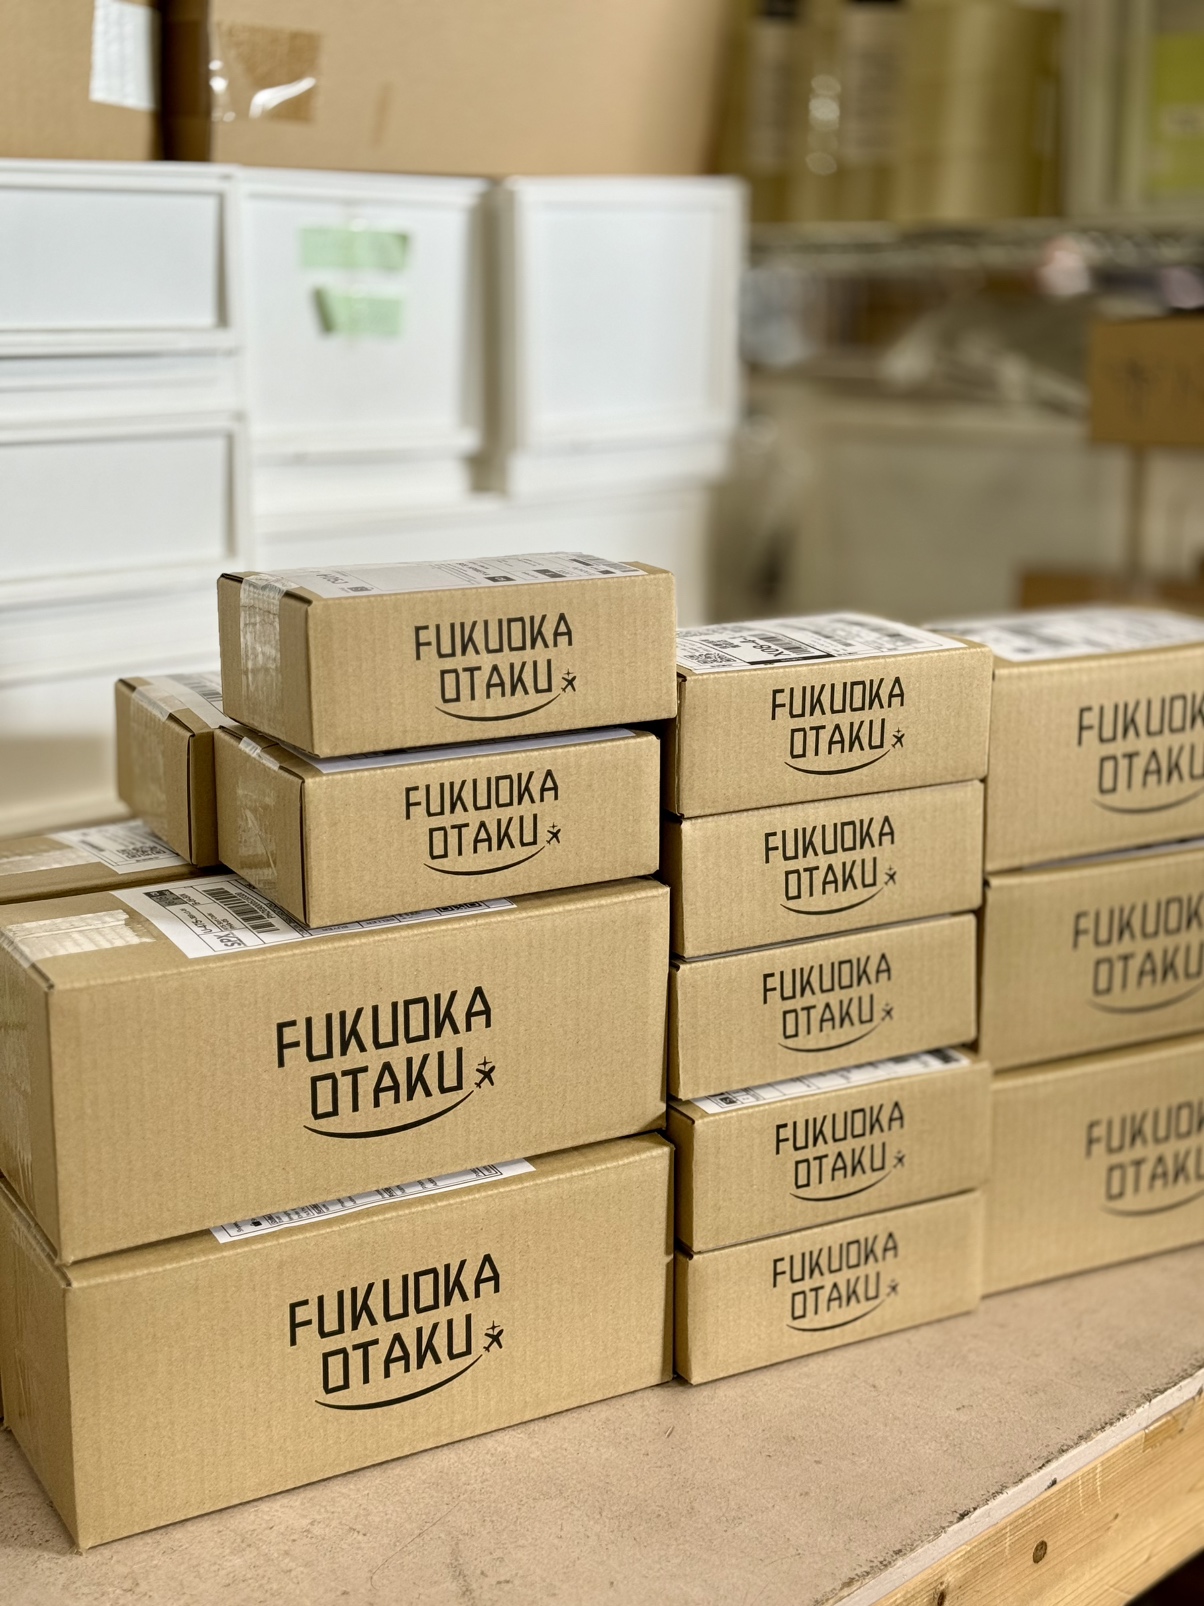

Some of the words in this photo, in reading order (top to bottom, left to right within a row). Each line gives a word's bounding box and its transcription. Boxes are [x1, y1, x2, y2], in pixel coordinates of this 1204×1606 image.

[414, 612, 573, 661] FUKUOKA
[439, 658, 553, 704] OTAKU
[771, 676, 905, 721] FUKUOKA
[789, 717, 886, 760] OTAKU
[404, 768, 559, 821] FUKUOKA
[1098, 743, 1204, 795] OTAKU
[428, 813, 538, 861] OTAKU
[764, 815, 895, 865] FUKUOKA
[784, 856, 877, 902] OTAKU
[762, 952, 891, 1005] FUKUOKA
[1093, 941, 1204, 996] OTAKU
[276, 985, 492, 1069] FUKUOKA
[782, 993, 874, 1040] OTAKU
[310, 1046, 464, 1121] OTAKU
[775, 1100, 904, 1156] FUKUOKA
[794, 1141, 886, 1190] OTAKU
[772, 1231, 898, 1289] FUKUOKA
[288, 1253, 500, 1347] FUKUOKA
[791, 1271, 880, 1321] OTAKU
[321, 1312, 472, 1395] OTAKU
